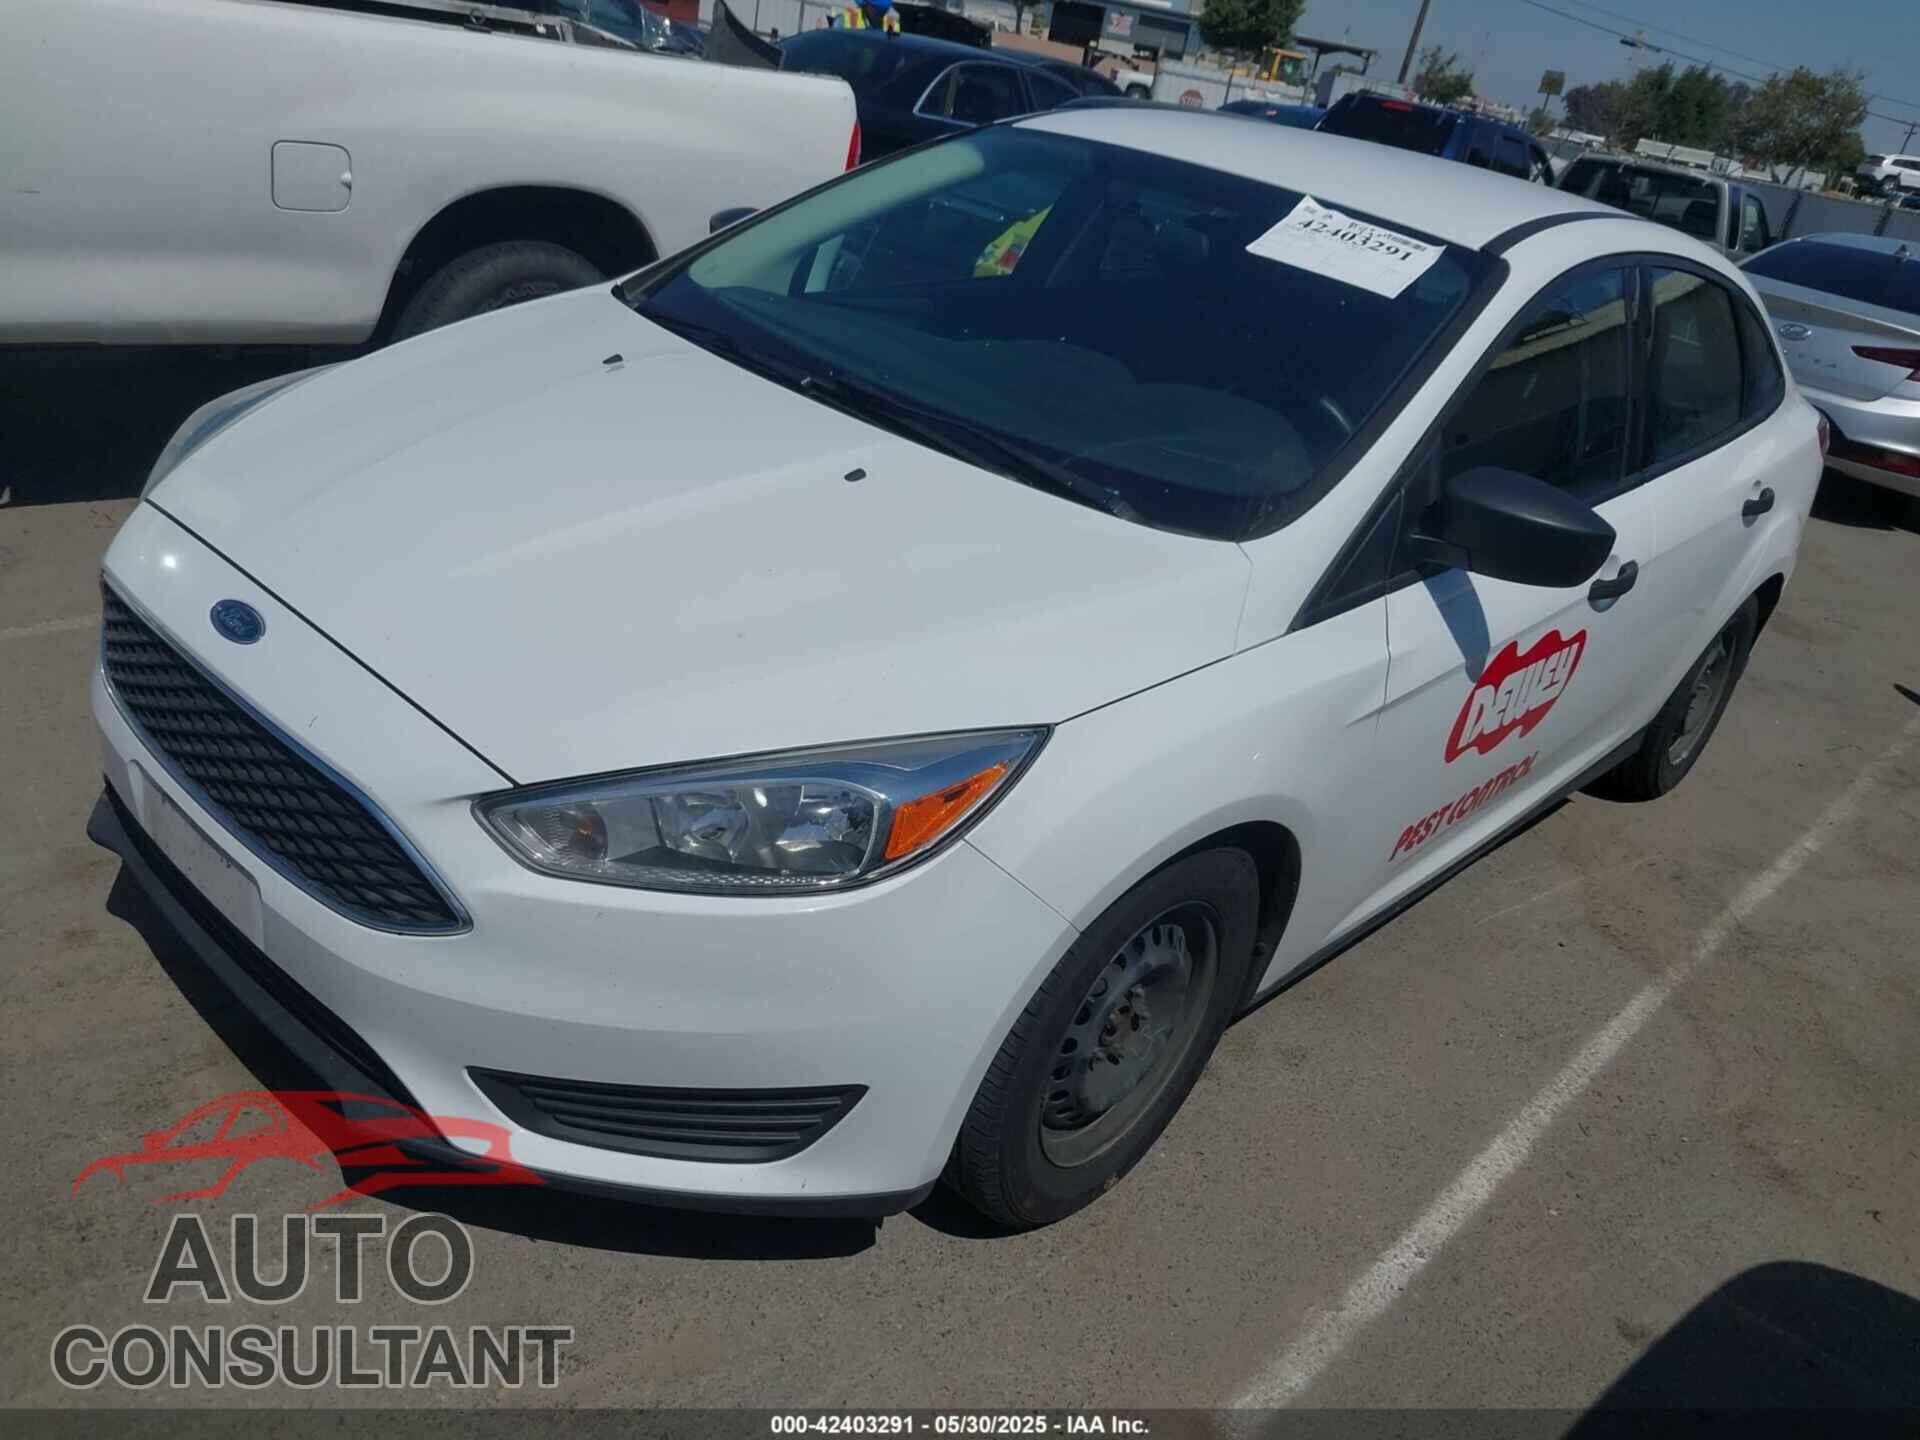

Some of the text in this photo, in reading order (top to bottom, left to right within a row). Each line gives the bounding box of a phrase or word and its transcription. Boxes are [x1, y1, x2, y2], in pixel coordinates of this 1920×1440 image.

[1298, 219, 1412, 261] 42403291
[1457, 642, 1581, 750] DEWEY
[1388, 800, 1454, 862] PEST
